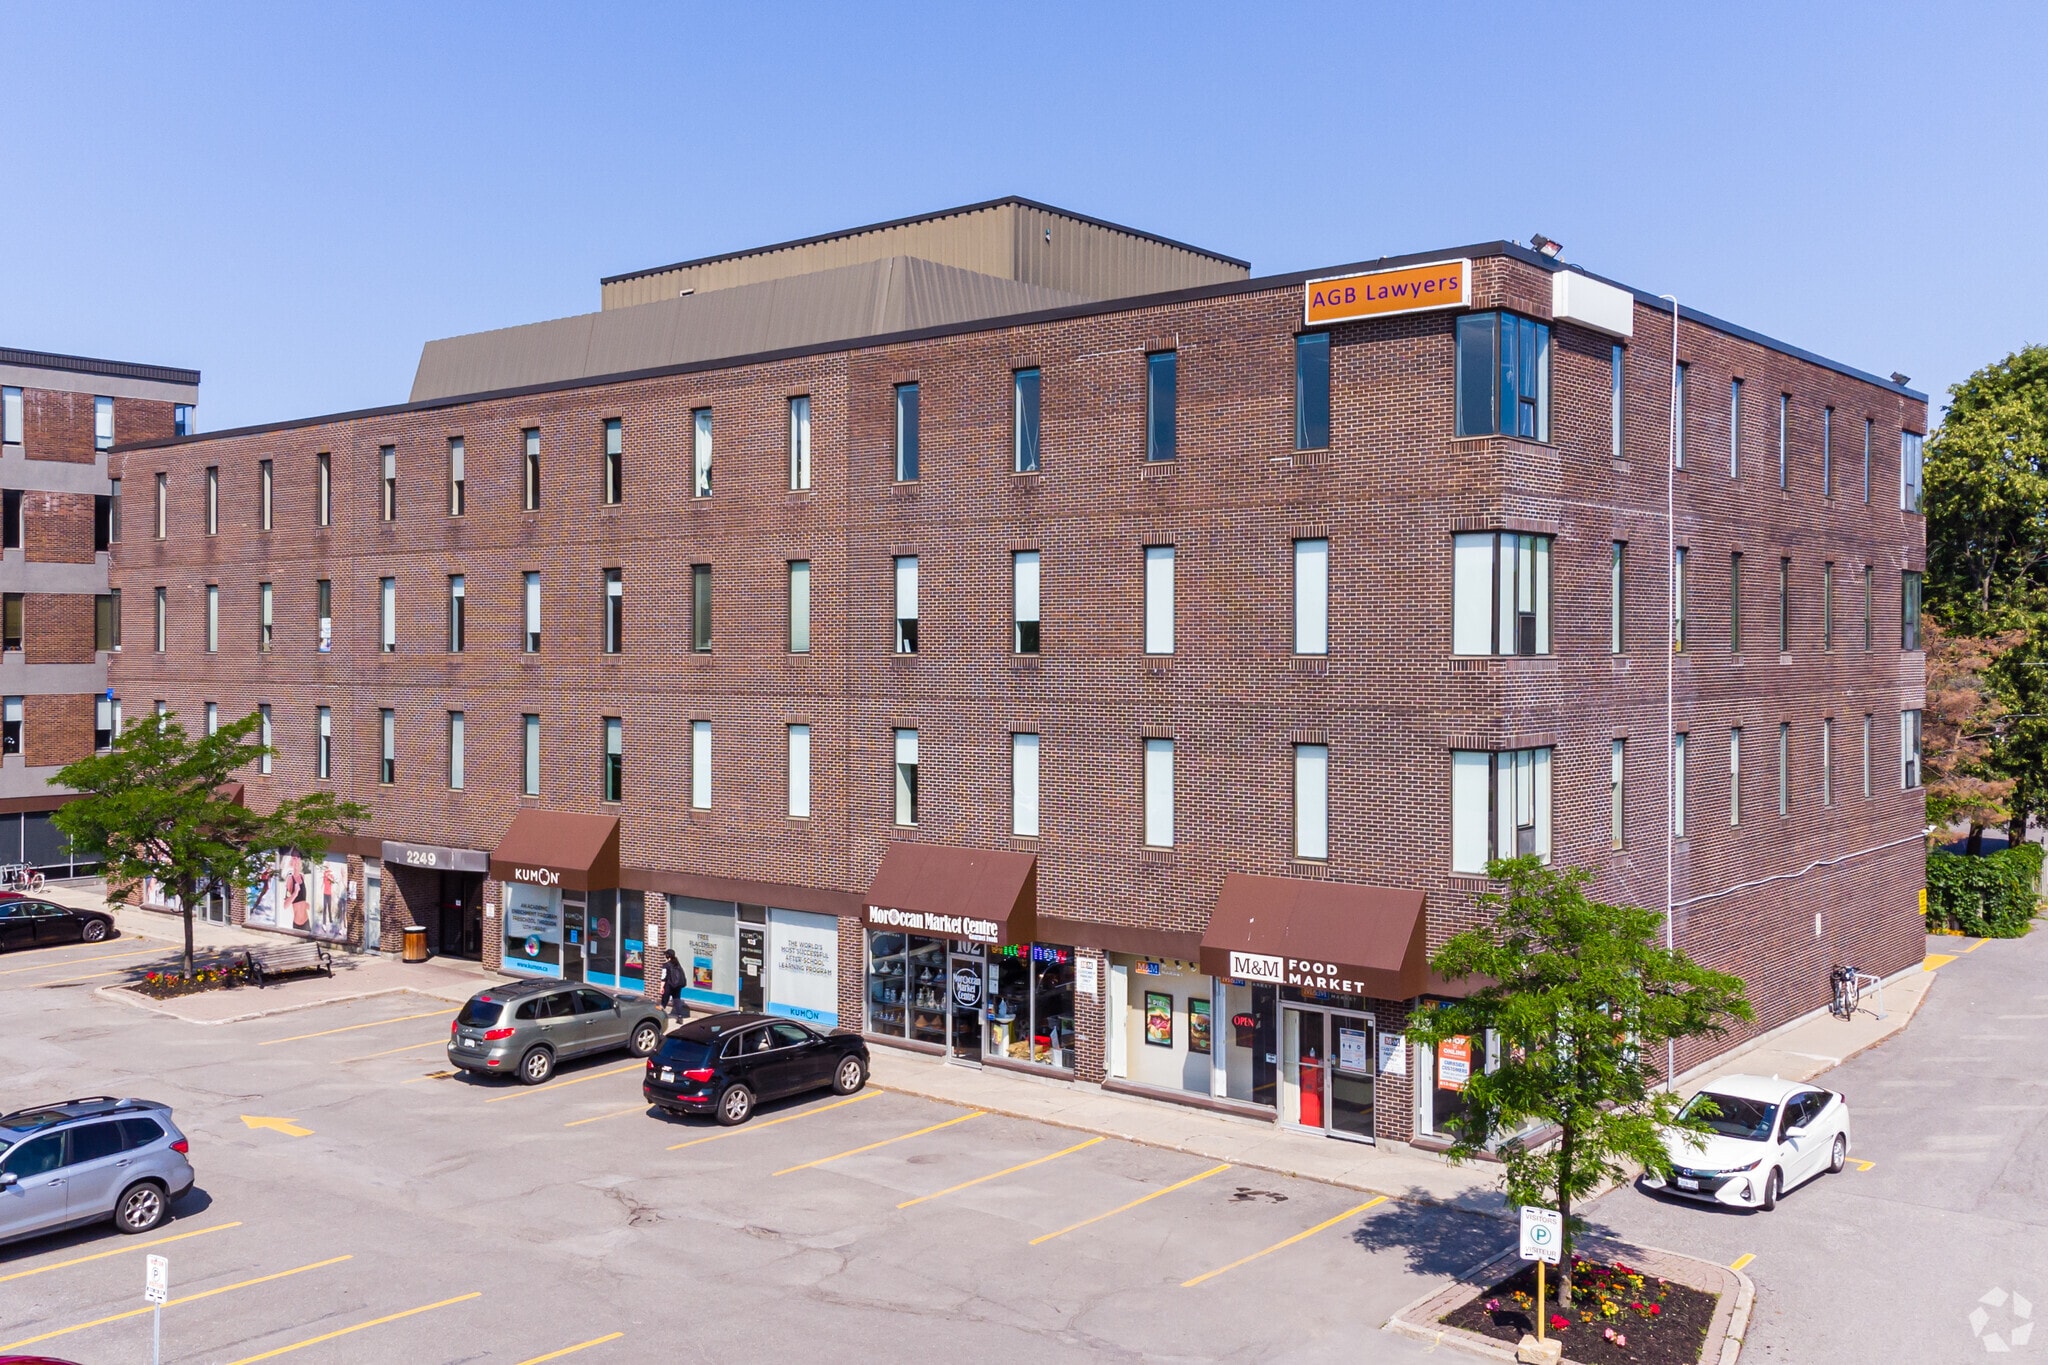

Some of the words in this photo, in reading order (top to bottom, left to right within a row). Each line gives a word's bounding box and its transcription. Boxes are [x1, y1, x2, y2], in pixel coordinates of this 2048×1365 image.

[1312, 287, 1357, 308] AGB
[1366, 276, 1458, 299] Lawyers
[406, 850, 436, 866] 2249
[515, 868, 560, 886] KUMON
[924, 912, 962, 934] Market
[963, 916, 998, 936] Centre
[741, 932, 763, 941] KUMON
[689, 940, 717, 950] PLACEMENT
[788, 939, 798, 947] THE
[800, 942, 823, 950] WORLD'S
[956, 940, 981, 955] 102
[796, 948, 829, 959] SUCCESSFUL
[779, 962, 804, 971] LEARNING
[806, 966, 832, 976] PROGRAM
[1234, 957, 1279, 978] M&M
[1288, 959, 1338, 976] FOOD
[957, 982, 976, 993] Market
[1288, 972, 1365, 993] MARKET
[957, 990, 976, 1002] Centre
[790, 1008, 820, 1019] KUMON
[1233, 1015, 1255, 1028] OPEN
[1443, 1047, 1466, 1057] ONLINE
[1525, 1213, 1558, 1225] VISITORS
[1536, 1228, 1547, 1241] P
[1525, 1246, 1557, 1257] VISITEUR
